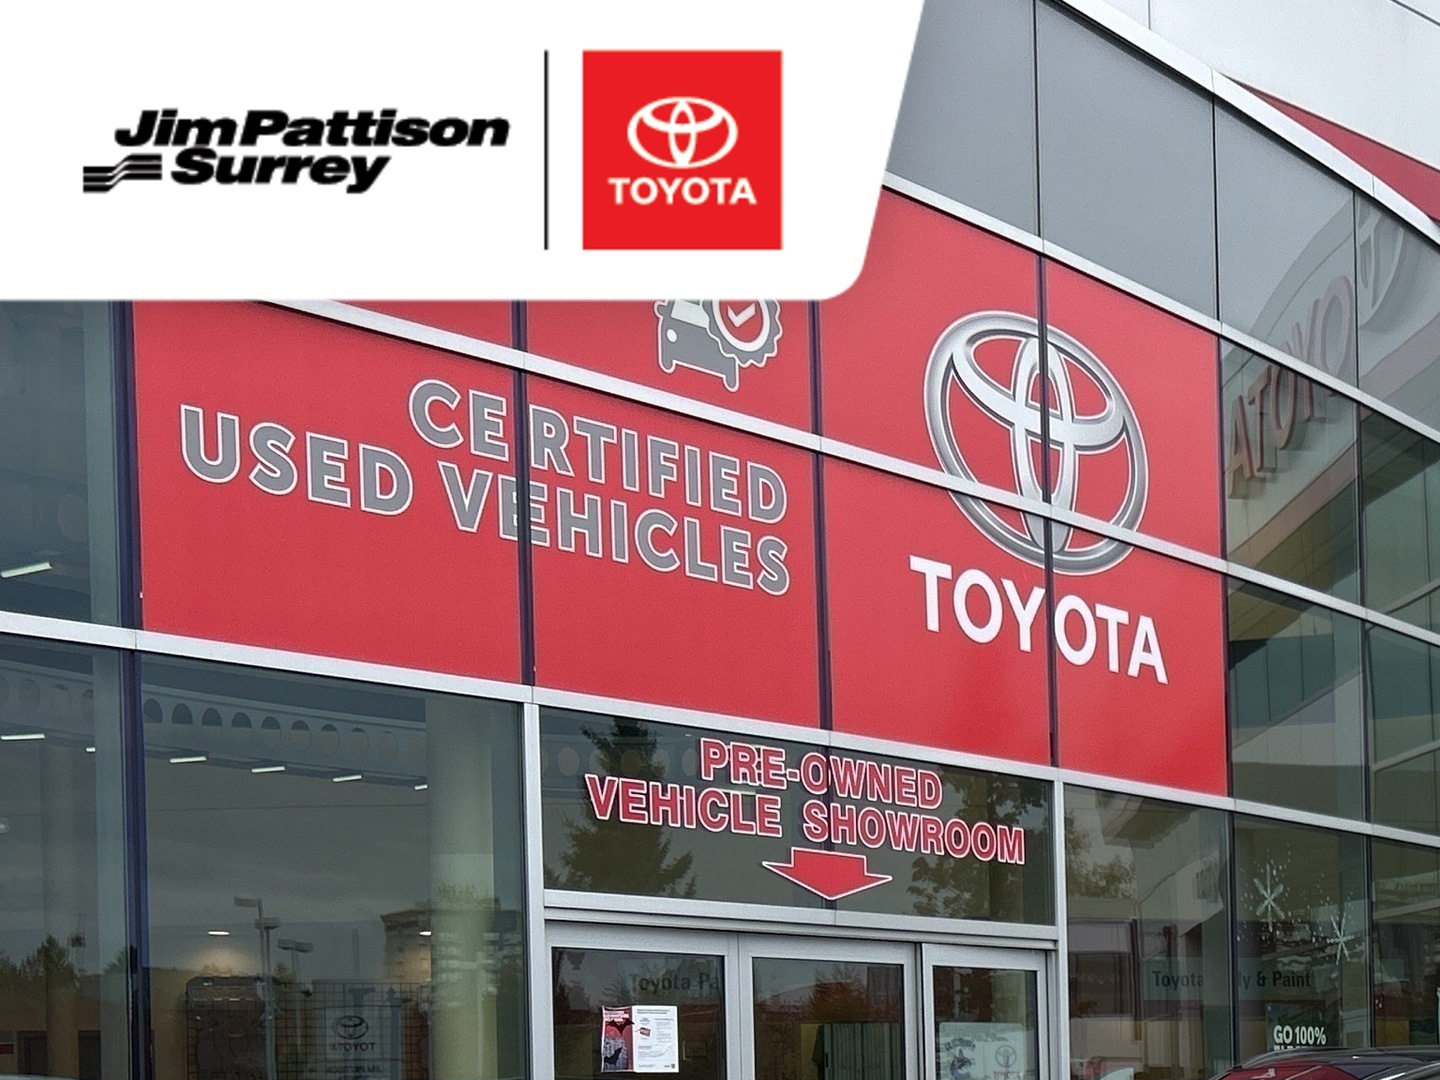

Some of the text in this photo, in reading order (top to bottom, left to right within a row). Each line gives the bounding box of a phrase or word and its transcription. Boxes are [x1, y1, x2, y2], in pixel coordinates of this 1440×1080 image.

[408, 379, 788, 524] CERTIFIED
[180, 403, 790, 596] USED VEHICLES
[909, 554, 1168, 685] TOYOTA
[700, 738, 943, 809] PRE-OWNED
[585, 773, 1025, 865] VEHICLE SHOWROOM
[628, 973, 691, 995] Toyota
[1152, 971, 1203, 990] Toyota
[1257, 970, 1267, 987] &
[1272, 970, 1312, 988] Paint
[1273, 1025, 1327, 1045] GO 100%
